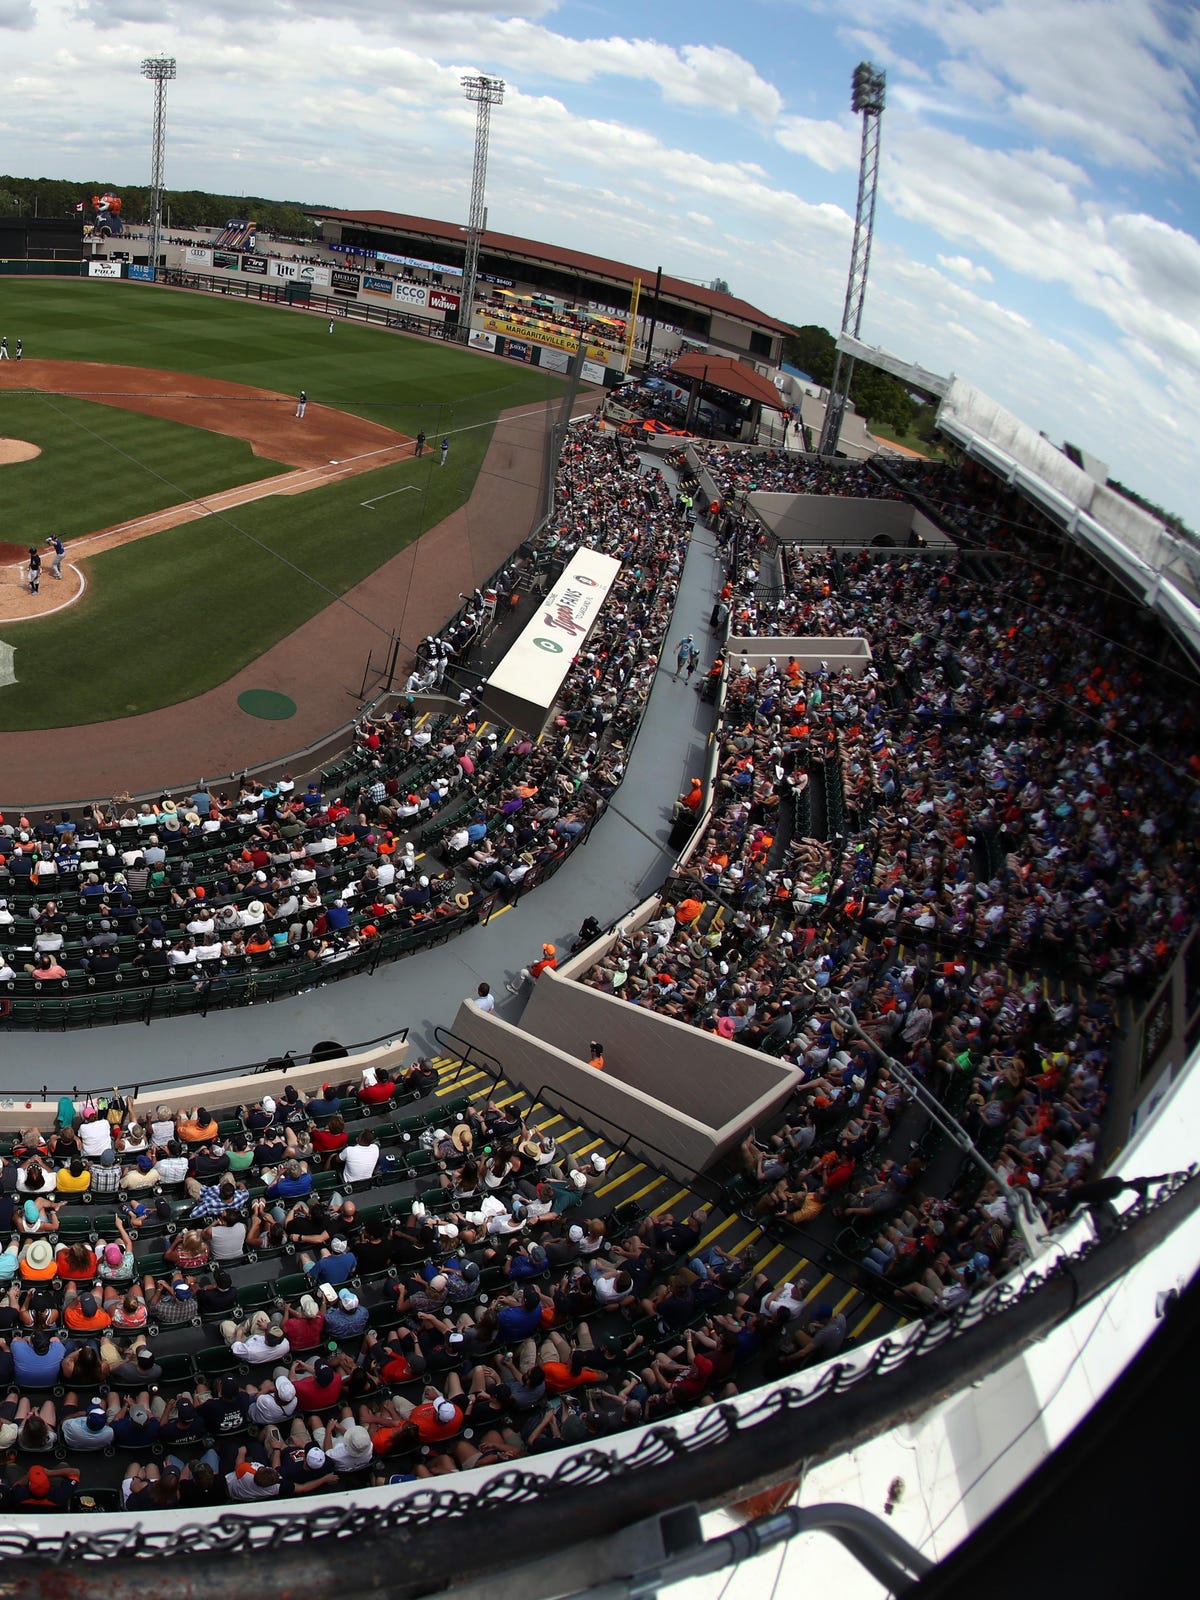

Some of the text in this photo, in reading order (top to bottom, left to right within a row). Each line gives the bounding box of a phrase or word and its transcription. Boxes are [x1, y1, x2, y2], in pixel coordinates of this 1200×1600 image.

[277, 264, 295, 277] Lite
[396, 285, 426, 298] ECCO
[396, 294, 425, 304] SUITES
[430, 296, 457, 310] Wawa
[506, 324, 565, 346] MARGARITAVILLE
[544, 588, 586, 637] Tigers FANS
